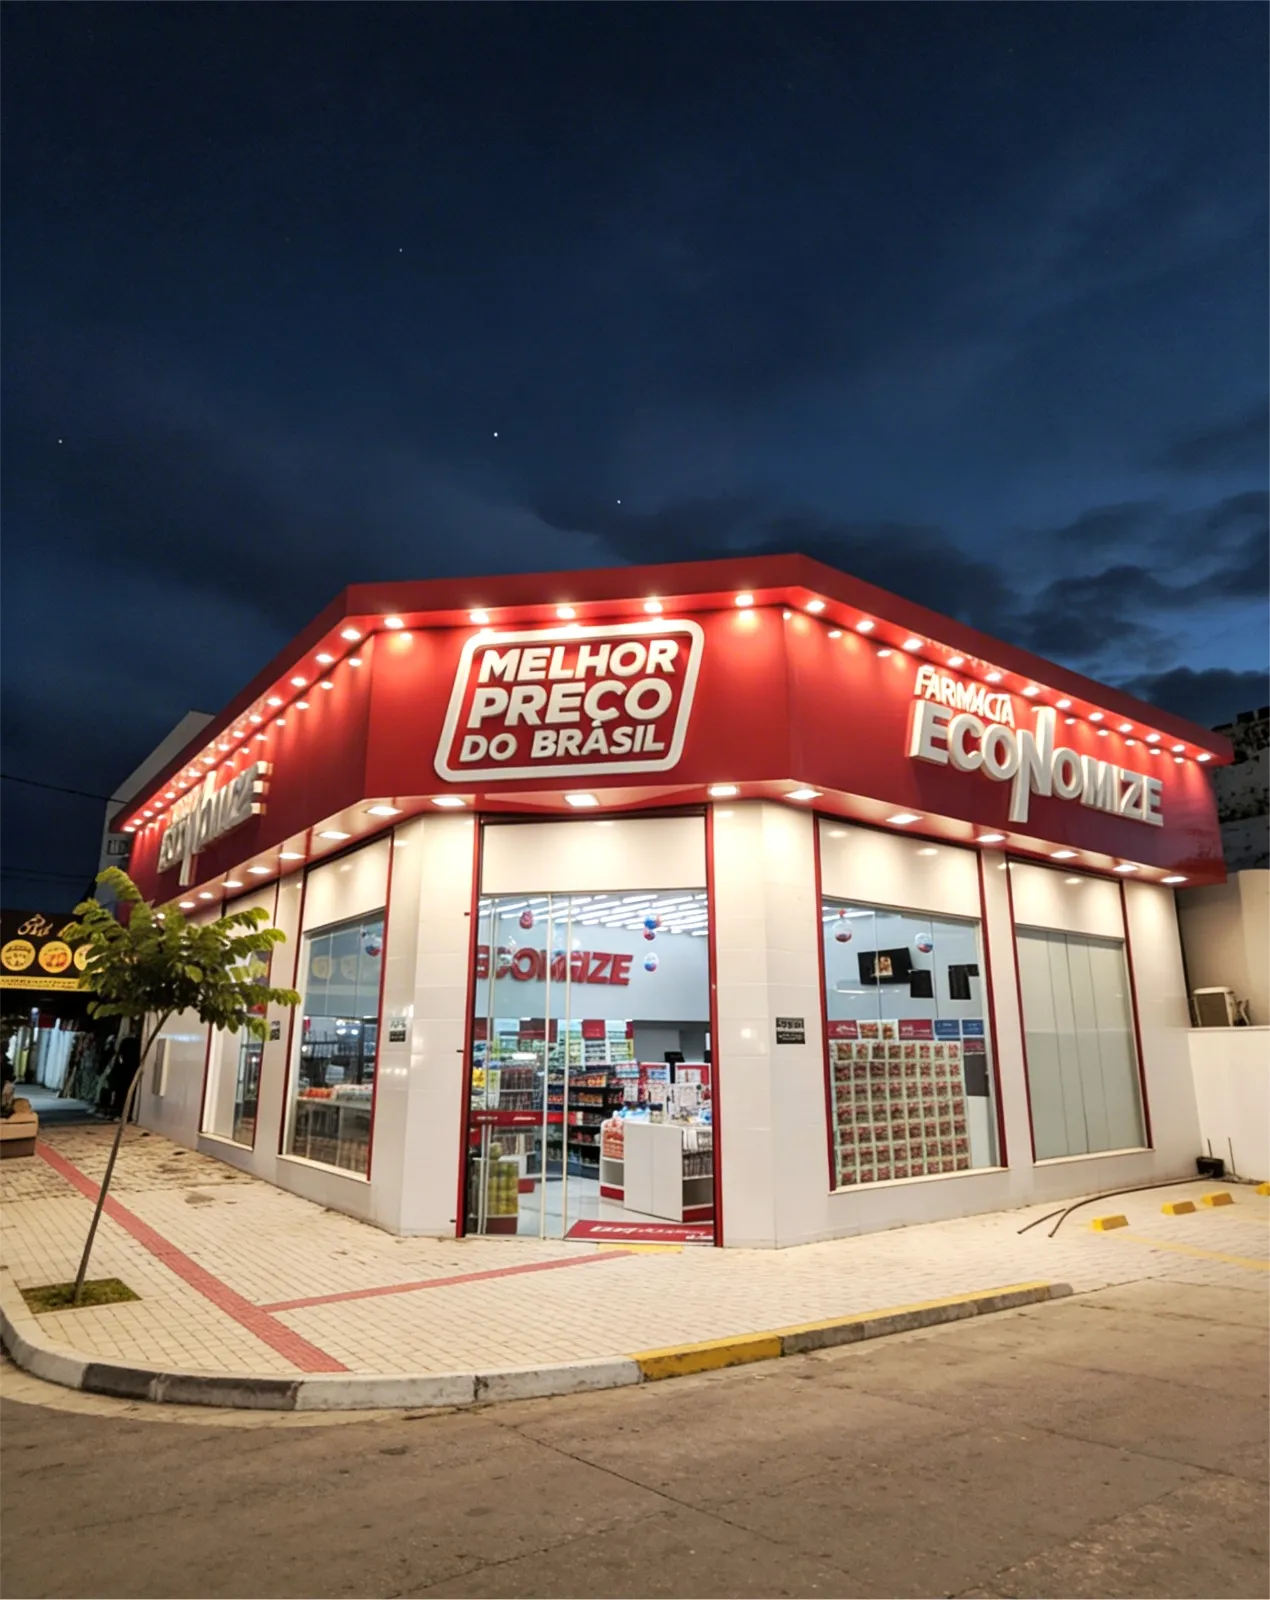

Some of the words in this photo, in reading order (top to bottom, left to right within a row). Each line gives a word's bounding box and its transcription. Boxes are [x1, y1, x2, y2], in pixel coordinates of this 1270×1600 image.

[478, 639, 679, 684] MELHOR
[466, 677, 673, 728] PREÇO
[459, 732, 518, 763] DO
[530, 724, 665, 759] BRASIL
[909, 699, 1164, 827] ECONOMIZE
